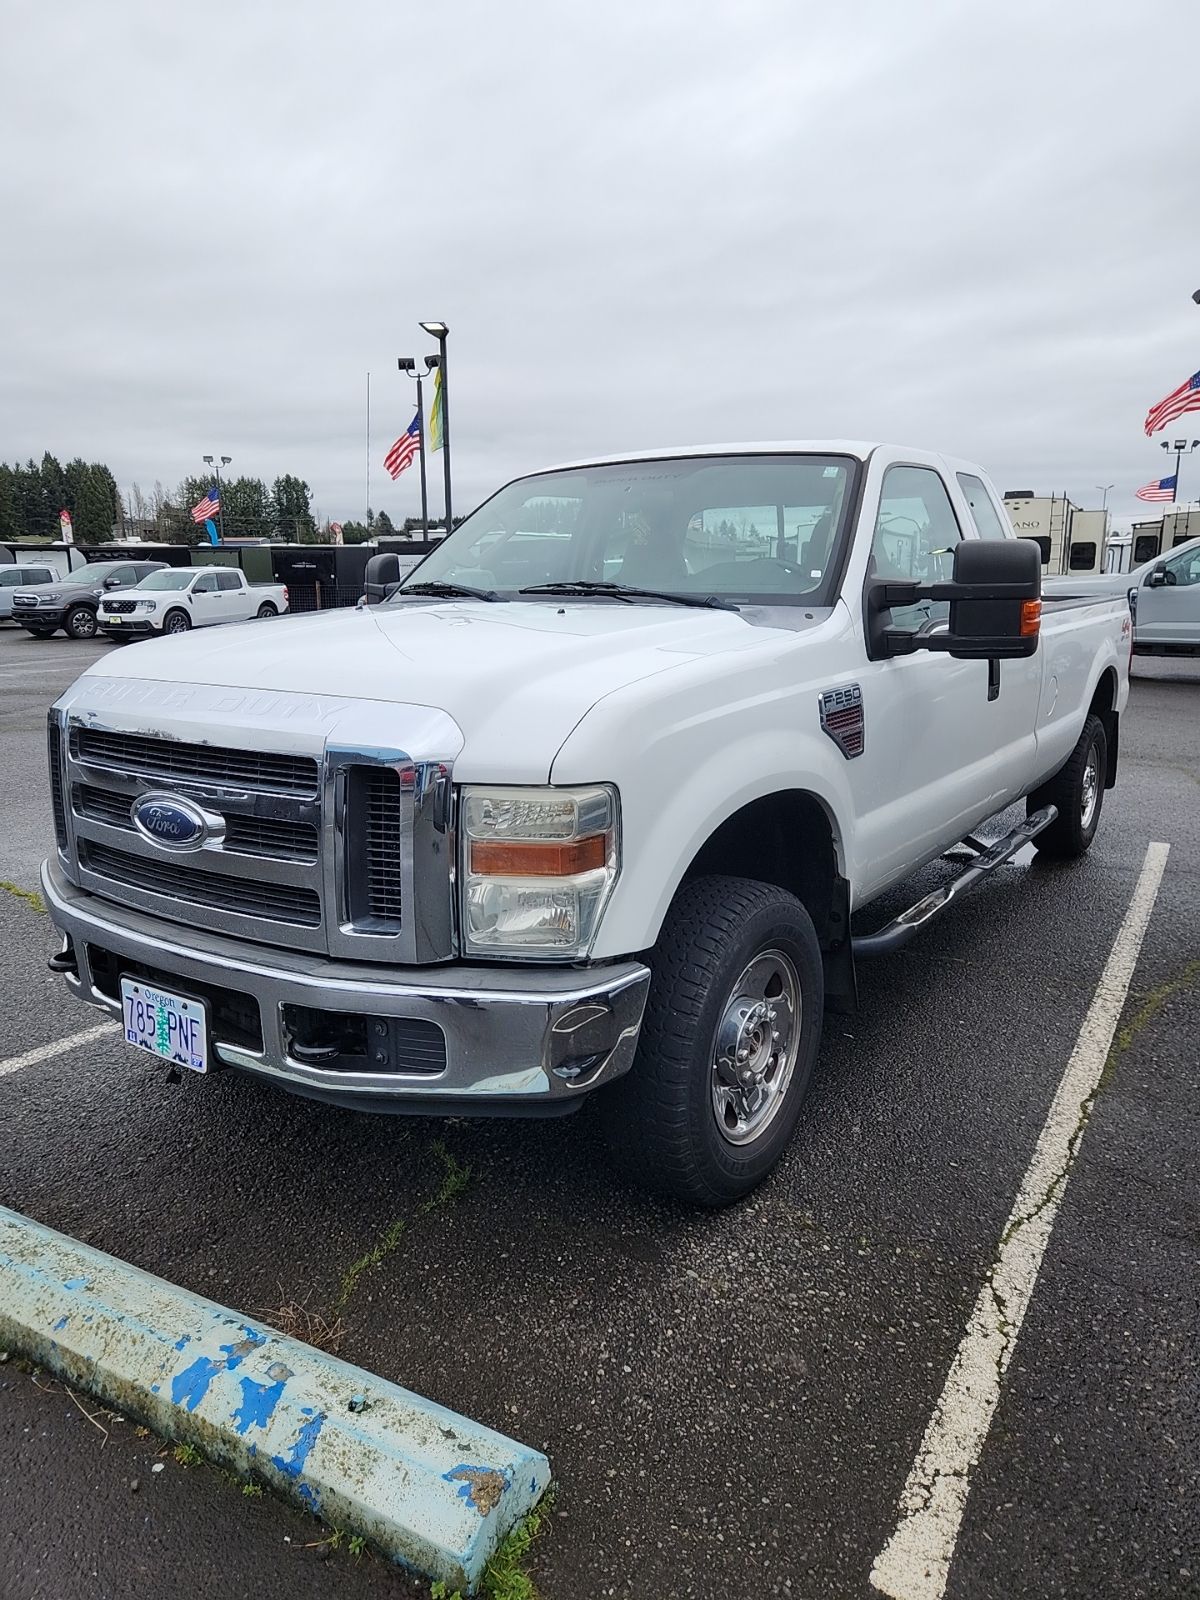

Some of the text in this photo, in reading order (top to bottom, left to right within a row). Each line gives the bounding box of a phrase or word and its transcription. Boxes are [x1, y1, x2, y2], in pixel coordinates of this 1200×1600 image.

[1013, 521, 1040, 529] ANO
[147, 807, 181, 835] Ford
[144, 989, 175, 1008] Oregon
[125, 995, 200, 1054] 785 PNF
